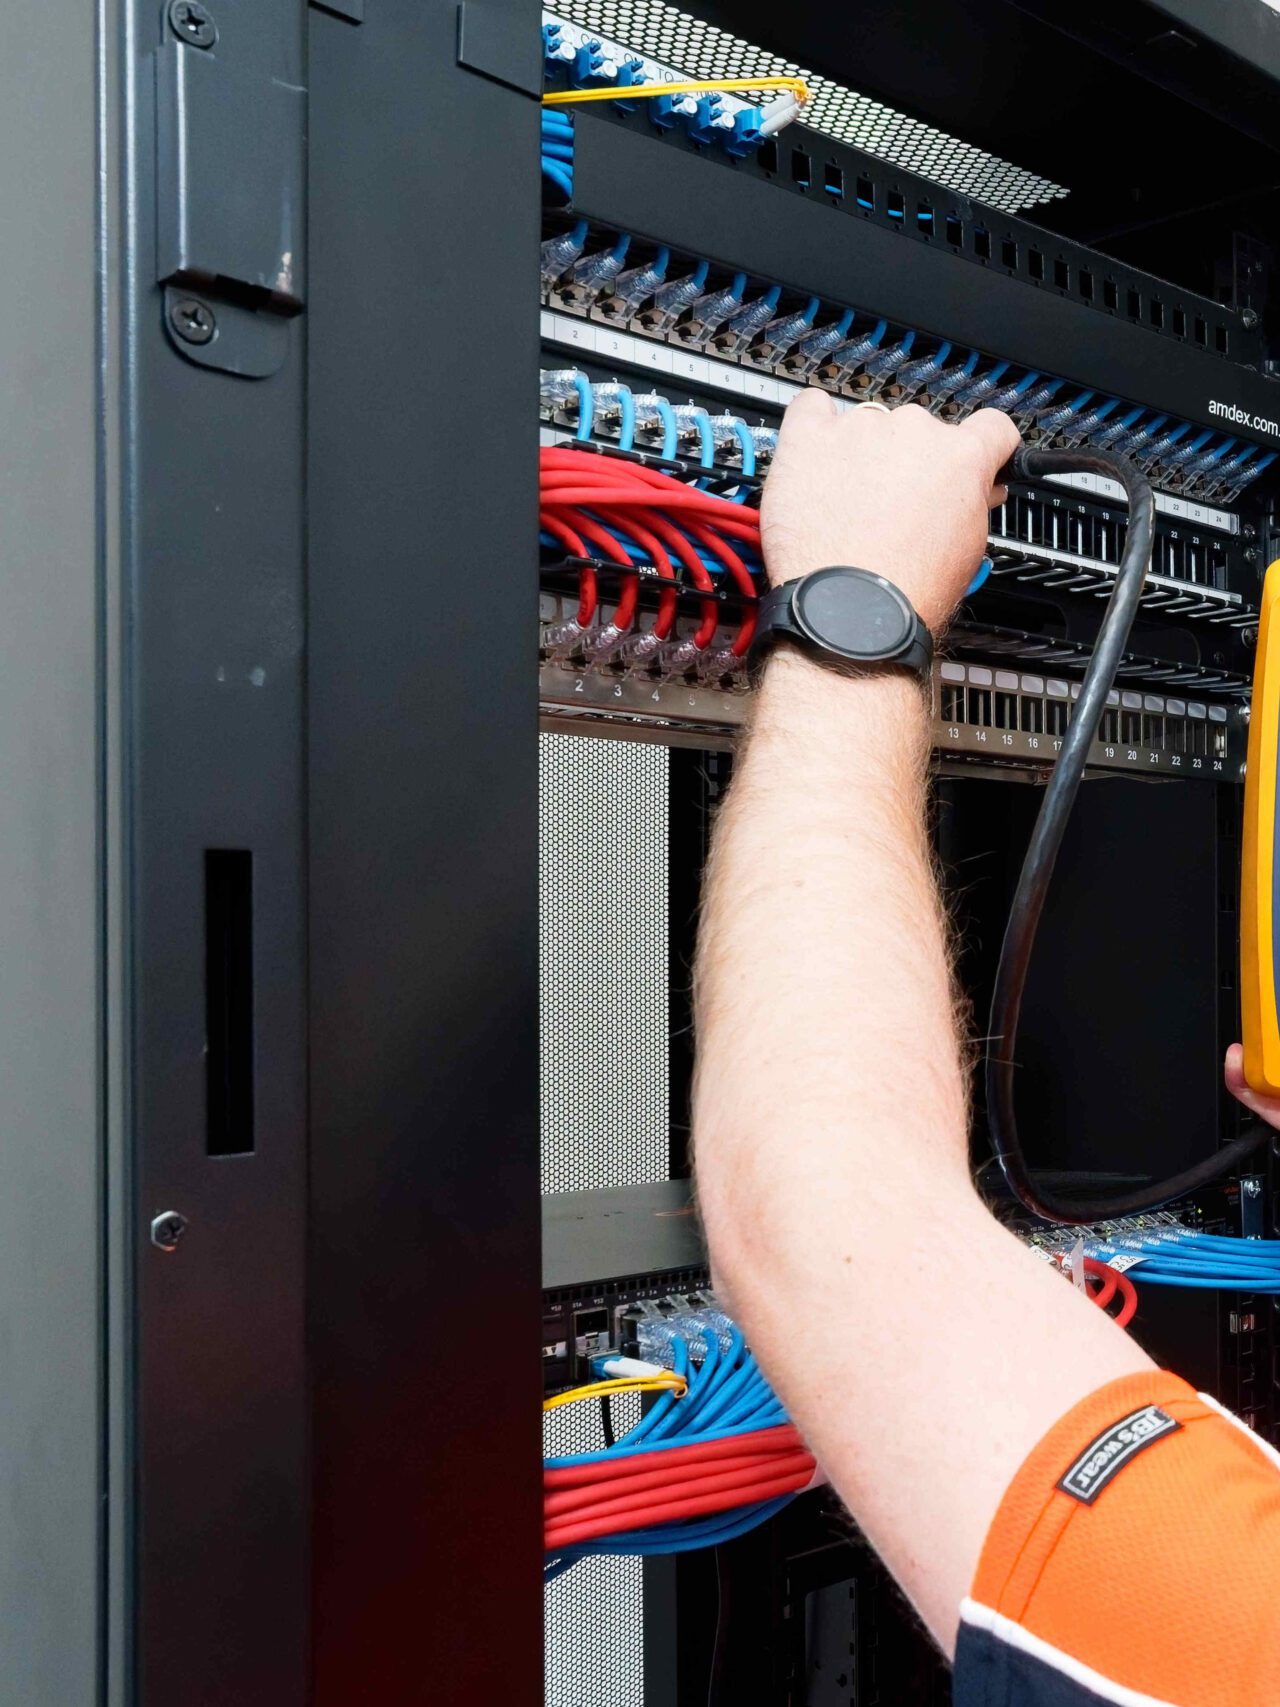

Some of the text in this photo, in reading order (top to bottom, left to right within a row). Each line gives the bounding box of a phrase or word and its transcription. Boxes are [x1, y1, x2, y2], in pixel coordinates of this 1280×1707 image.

[572, 330, 578, 339] 2
[613, 341, 618, 350] 3
[651, 353, 656, 361] 4
[689, 363, 694, 372] 5
[725, 374, 730, 382] 6
[760, 384, 765, 392] 7
[1173, 503, 1179, 511] 22
[650, 388, 656, 396] 4
[688, 399, 694, 408] 5
[760, 418, 765, 427] 7
[1028, 491, 1035, 500] 16
[1053, 499, 1060, 507] 17
[1078, 505, 1085, 514] 18
[1102, 511, 1110, 520] 19
[1170, 530, 1178, 539] 22
[1192, 536, 1200, 544] 23
[1213, 542, 1220, 550] 24
[575, 679, 583, 692] 2
[614, 684, 622, 697] 3
[652, 690, 660, 702] 4
[948, 727, 959, 738] 13
[976, 731, 986, 742] 14
[1002, 734, 1013, 745] 15
[1028, 737, 1039, 749] 16
[1105, 747, 1115, 758] 19
[1127, 750, 1137, 760] 20
[1150, 753, 1159, 763] 21
[1172, 755, 1181, 766] 22
[1193, 758, 1202, 768] 23
[1213, 761, 1222, 771] 24
[1076, 1409, 1166, 1488] JB's wear
